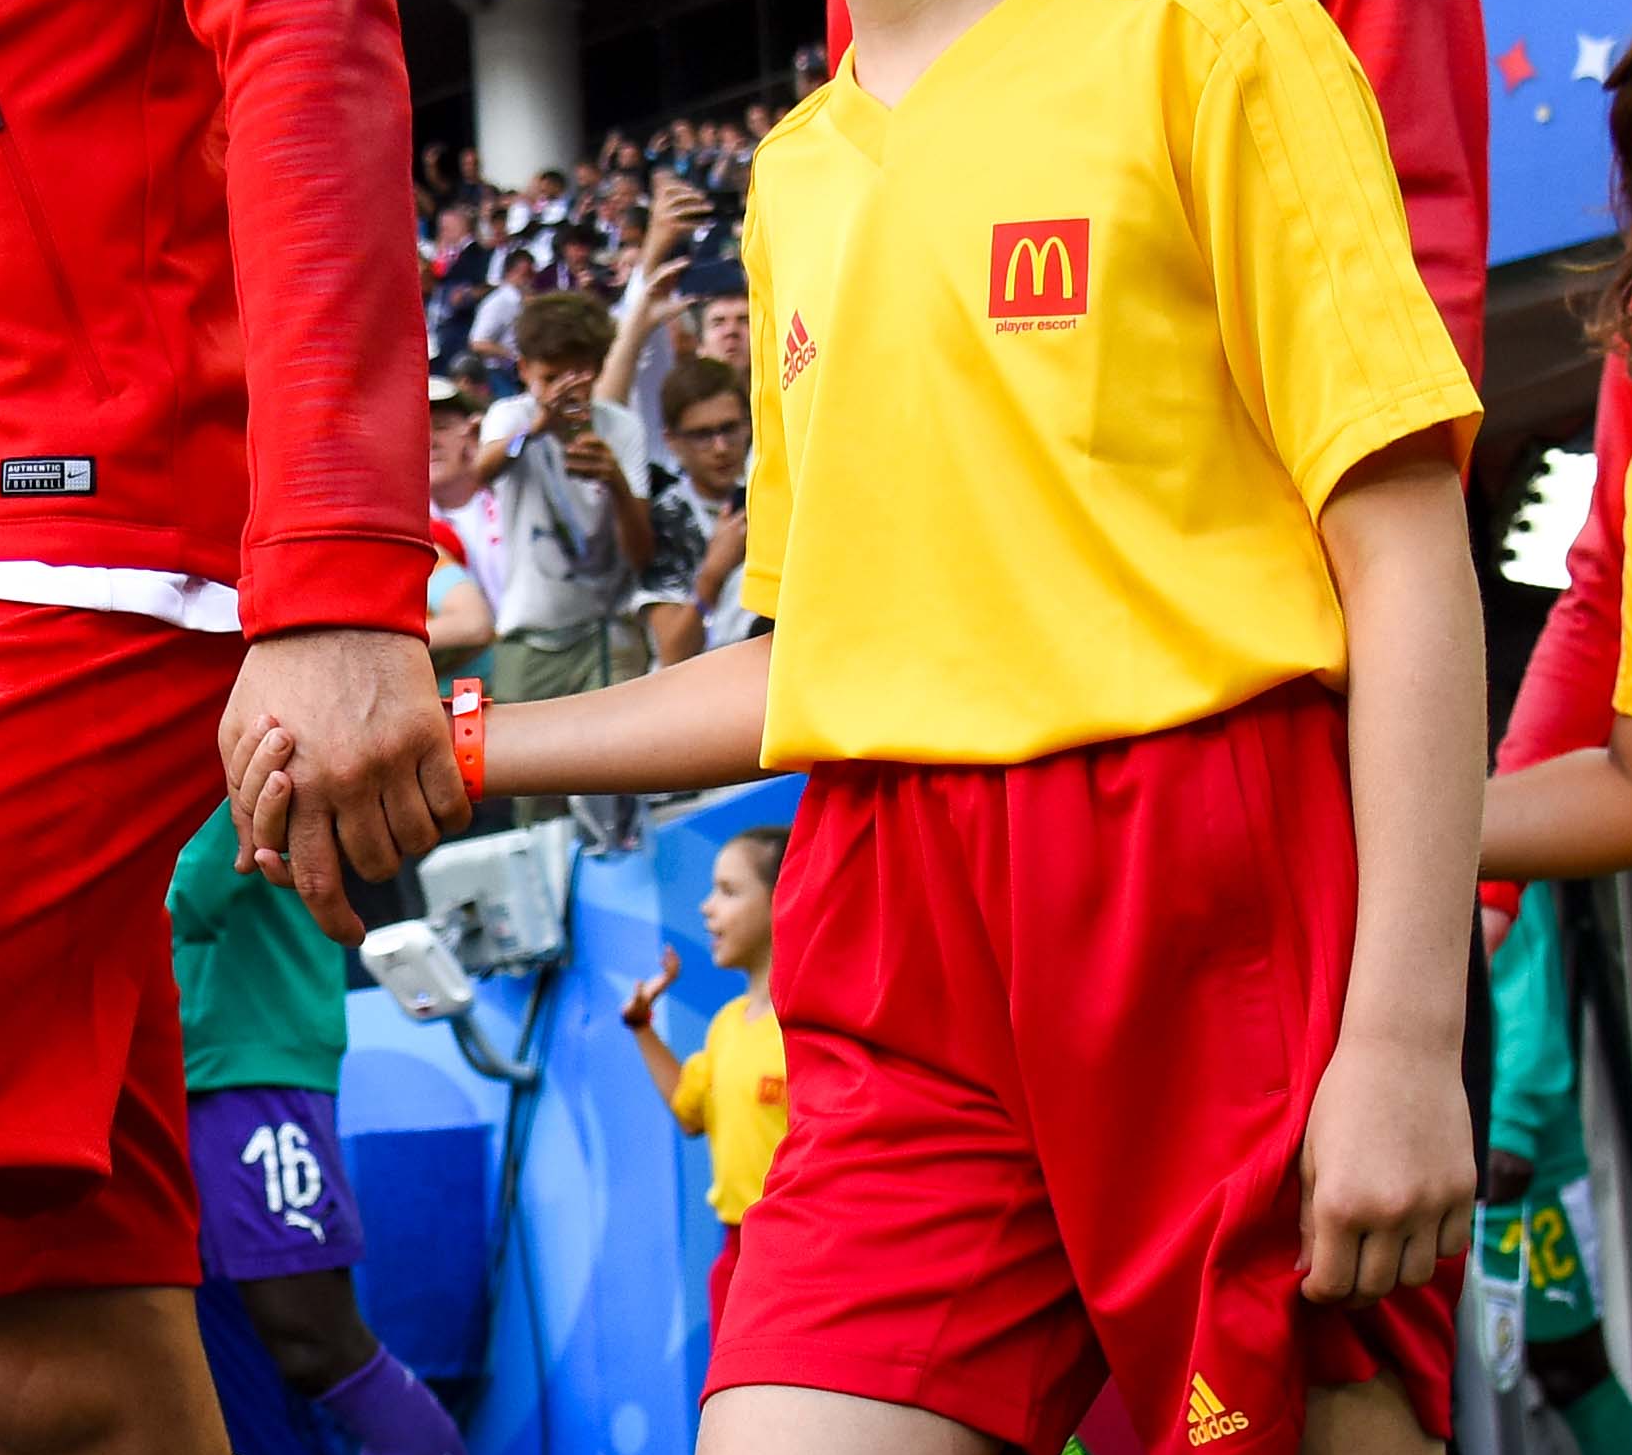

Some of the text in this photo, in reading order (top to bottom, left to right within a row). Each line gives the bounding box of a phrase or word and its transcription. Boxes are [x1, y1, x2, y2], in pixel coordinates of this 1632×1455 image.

[995, 317, 1077, 335] player escort
[781, 340, 817, 392] adidas
[7, 464, 61, 473] AUTHENTIC
[6, 479, 61, 489] FOOTBALL
[241, 1122, 322, 1213] 16
[1188, 1411, 1250, 1447] adidas
